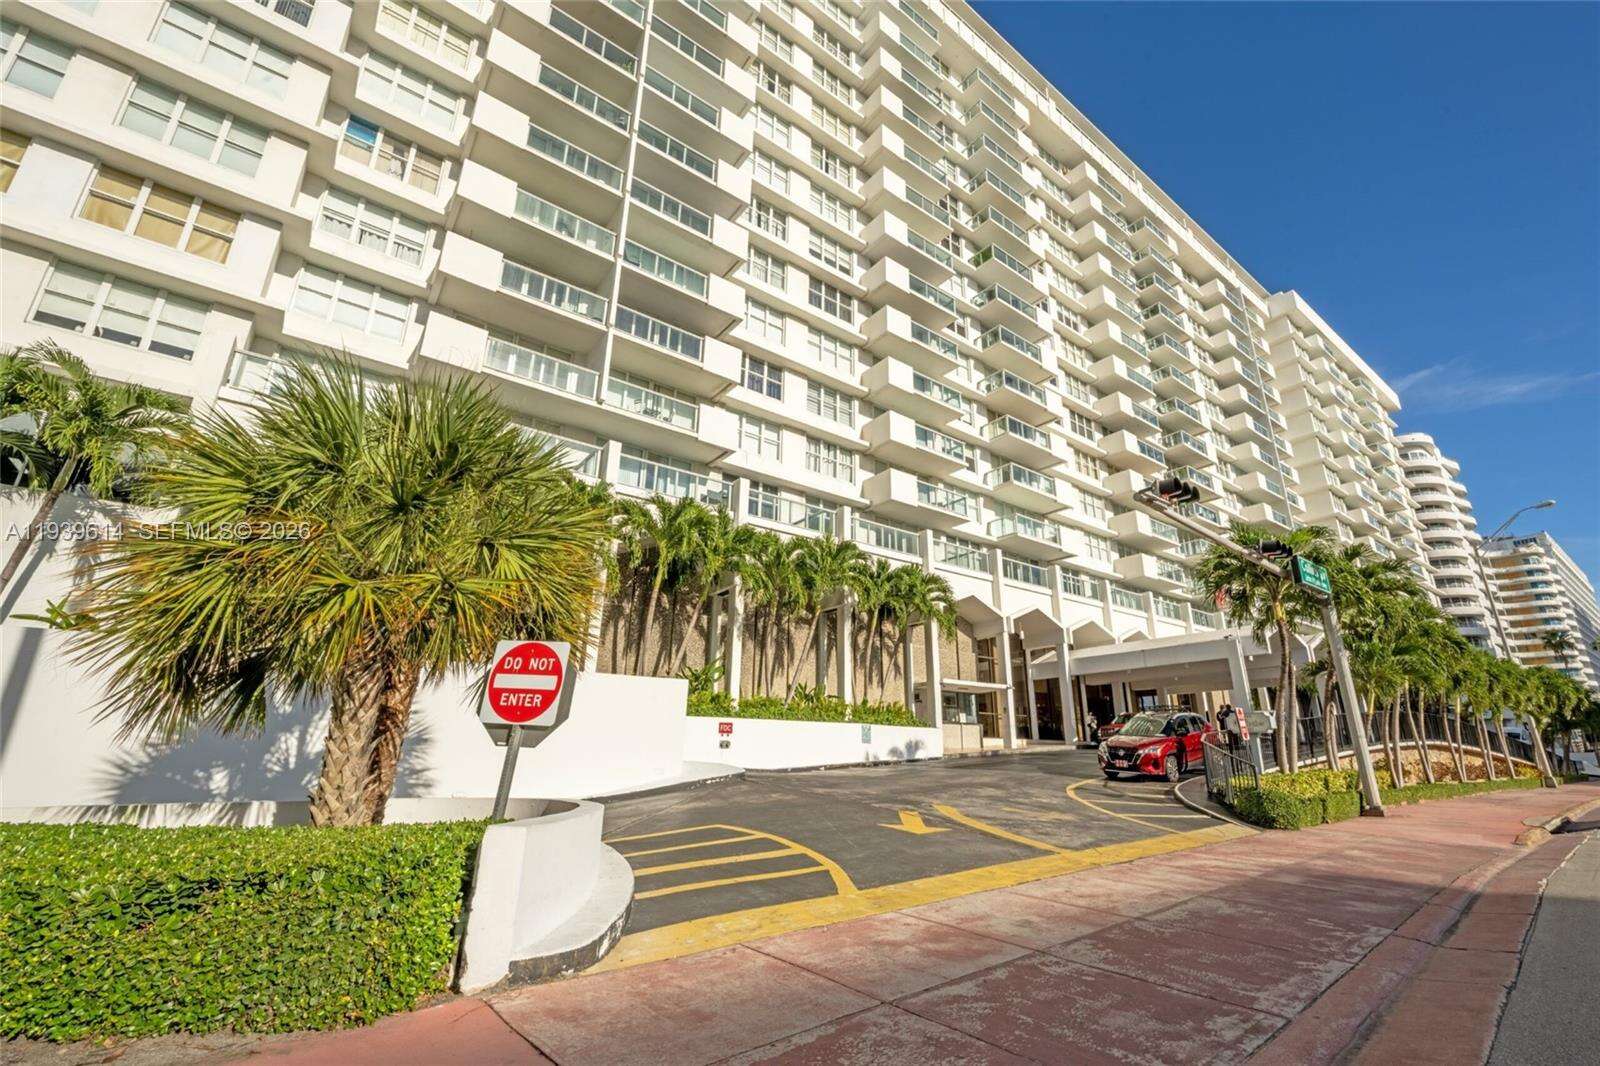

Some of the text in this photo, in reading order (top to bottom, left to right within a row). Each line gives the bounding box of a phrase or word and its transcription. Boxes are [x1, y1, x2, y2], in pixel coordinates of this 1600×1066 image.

[504, 657, 556, 671] DO NOT
[499, 693, 543, 707] ENTER
